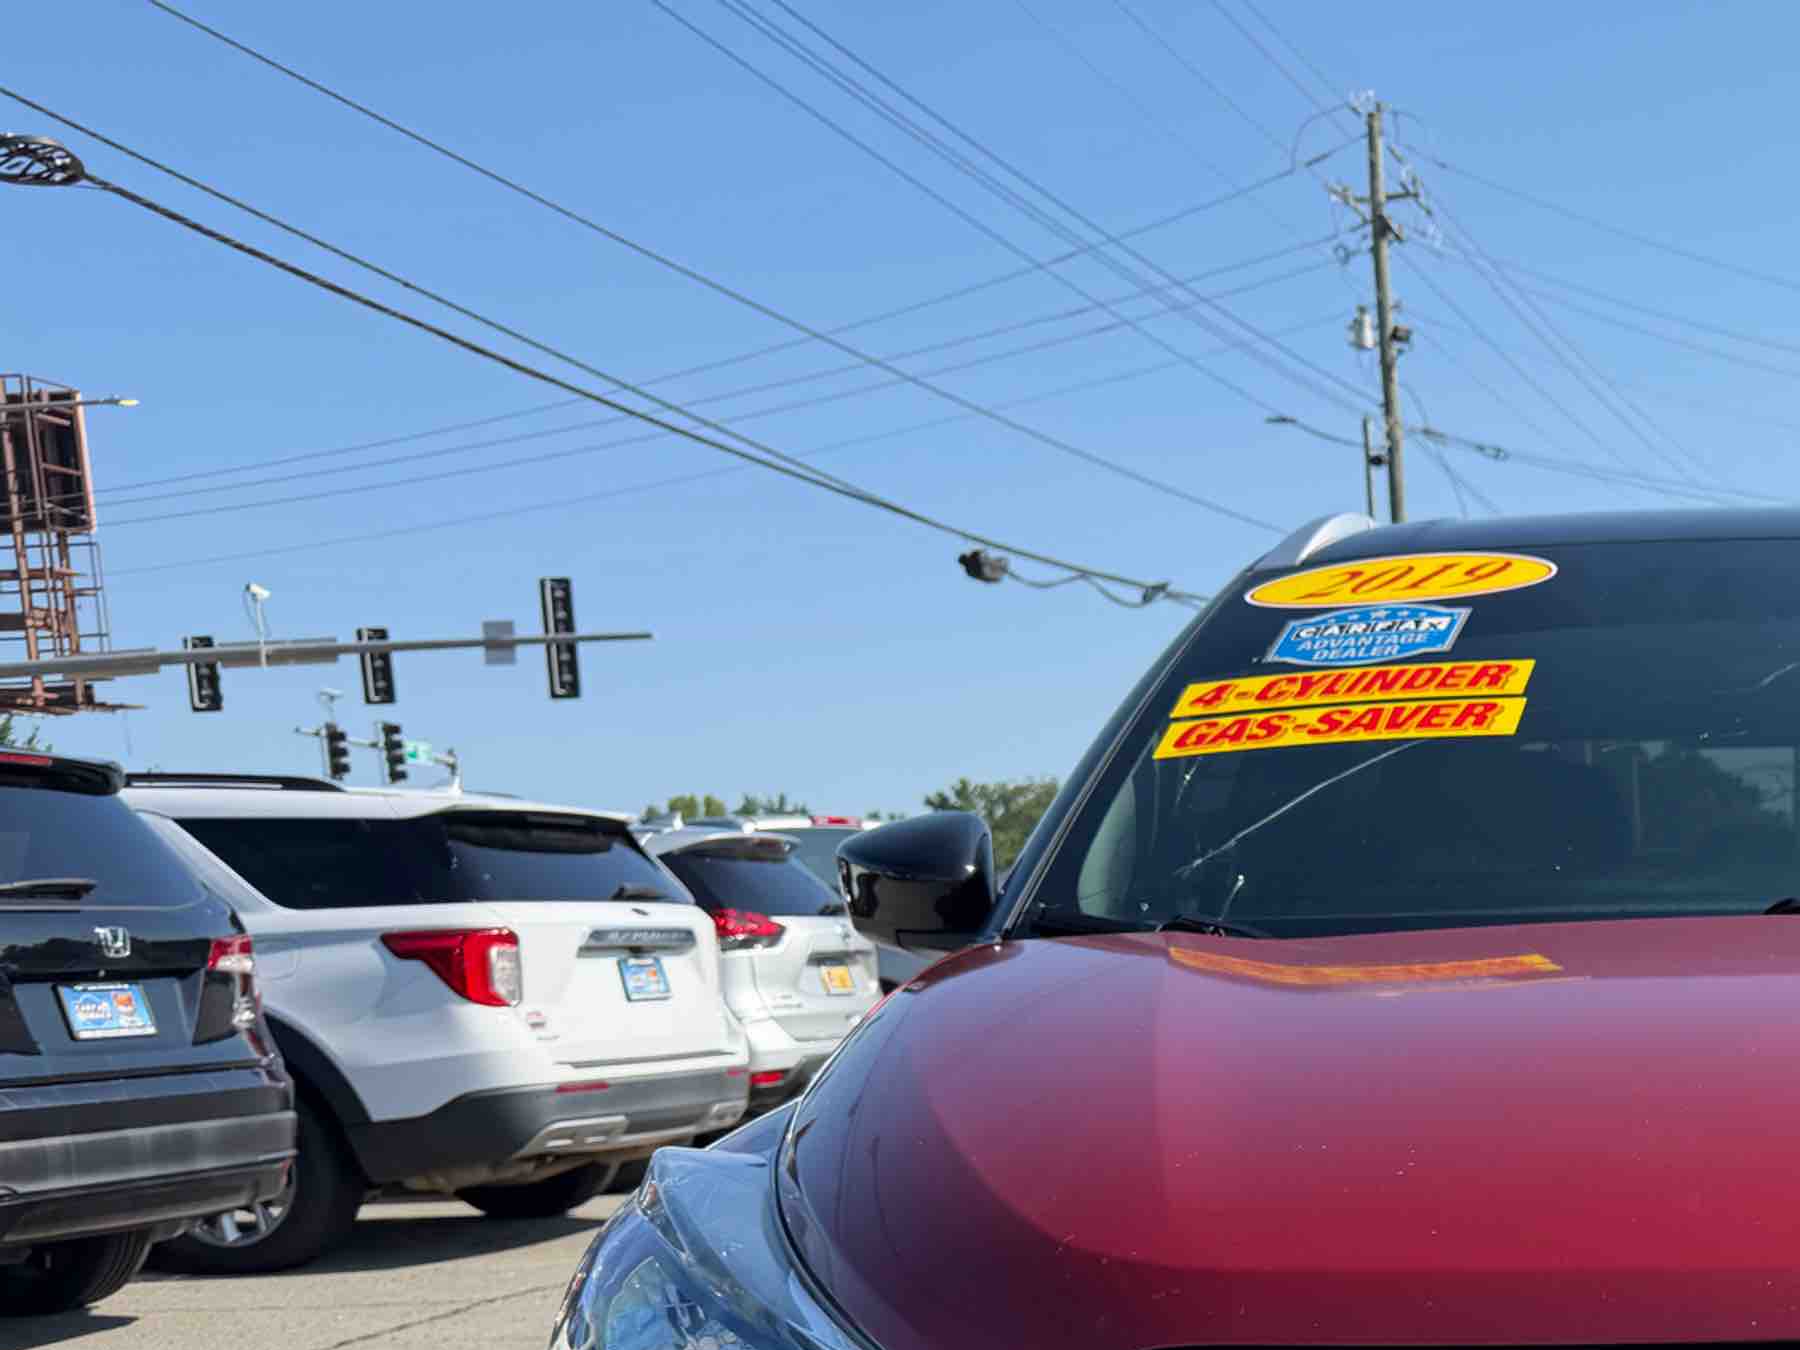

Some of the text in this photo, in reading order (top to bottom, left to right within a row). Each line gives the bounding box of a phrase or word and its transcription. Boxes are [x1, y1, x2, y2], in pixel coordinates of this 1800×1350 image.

[1303, 561, 1514, 599] 2019
[1297, 634, 1427, 651] ADVANTAGE
[1312, 645, 1400, 661] DEALER
[1189, 664, 1516, 709] 4-CYLINDER
[1173, 702, 1498, 751] GAS-SAVER
